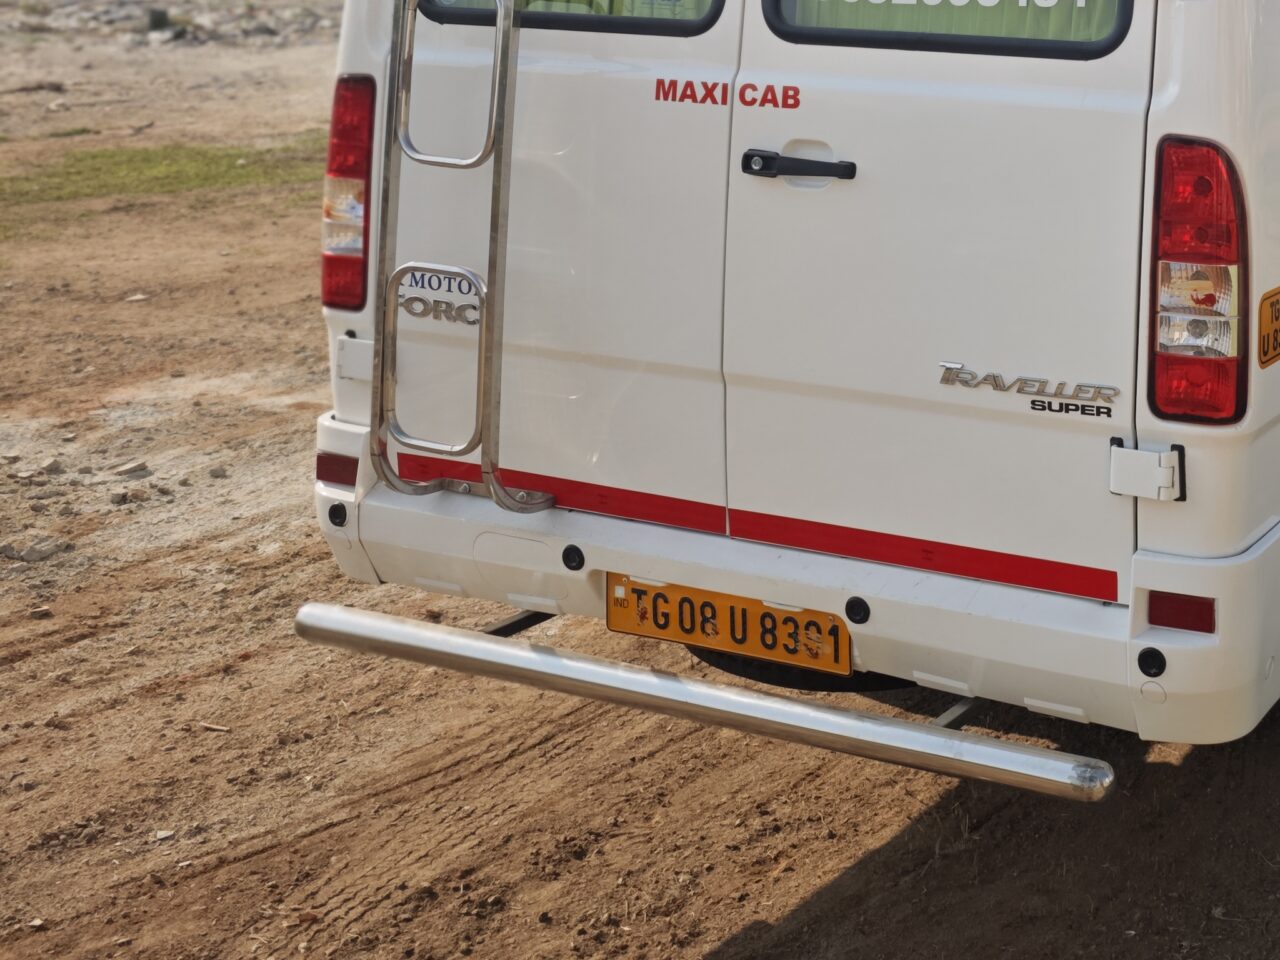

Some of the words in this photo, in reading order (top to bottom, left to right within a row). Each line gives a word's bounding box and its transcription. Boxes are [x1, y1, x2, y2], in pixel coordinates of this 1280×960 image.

[655, 78, 729, 106] MAXI
[738, 83, 801, 109] CAB
[408, 271, 479, 297] MOTO
[398, 294, 480, 326] ORC
[1262, 333, 1270, 357] U
[1030, 399, 1112, 418] SUPER
[613, 598, 630, 609] IND
[729, 605, 748, 645] U
